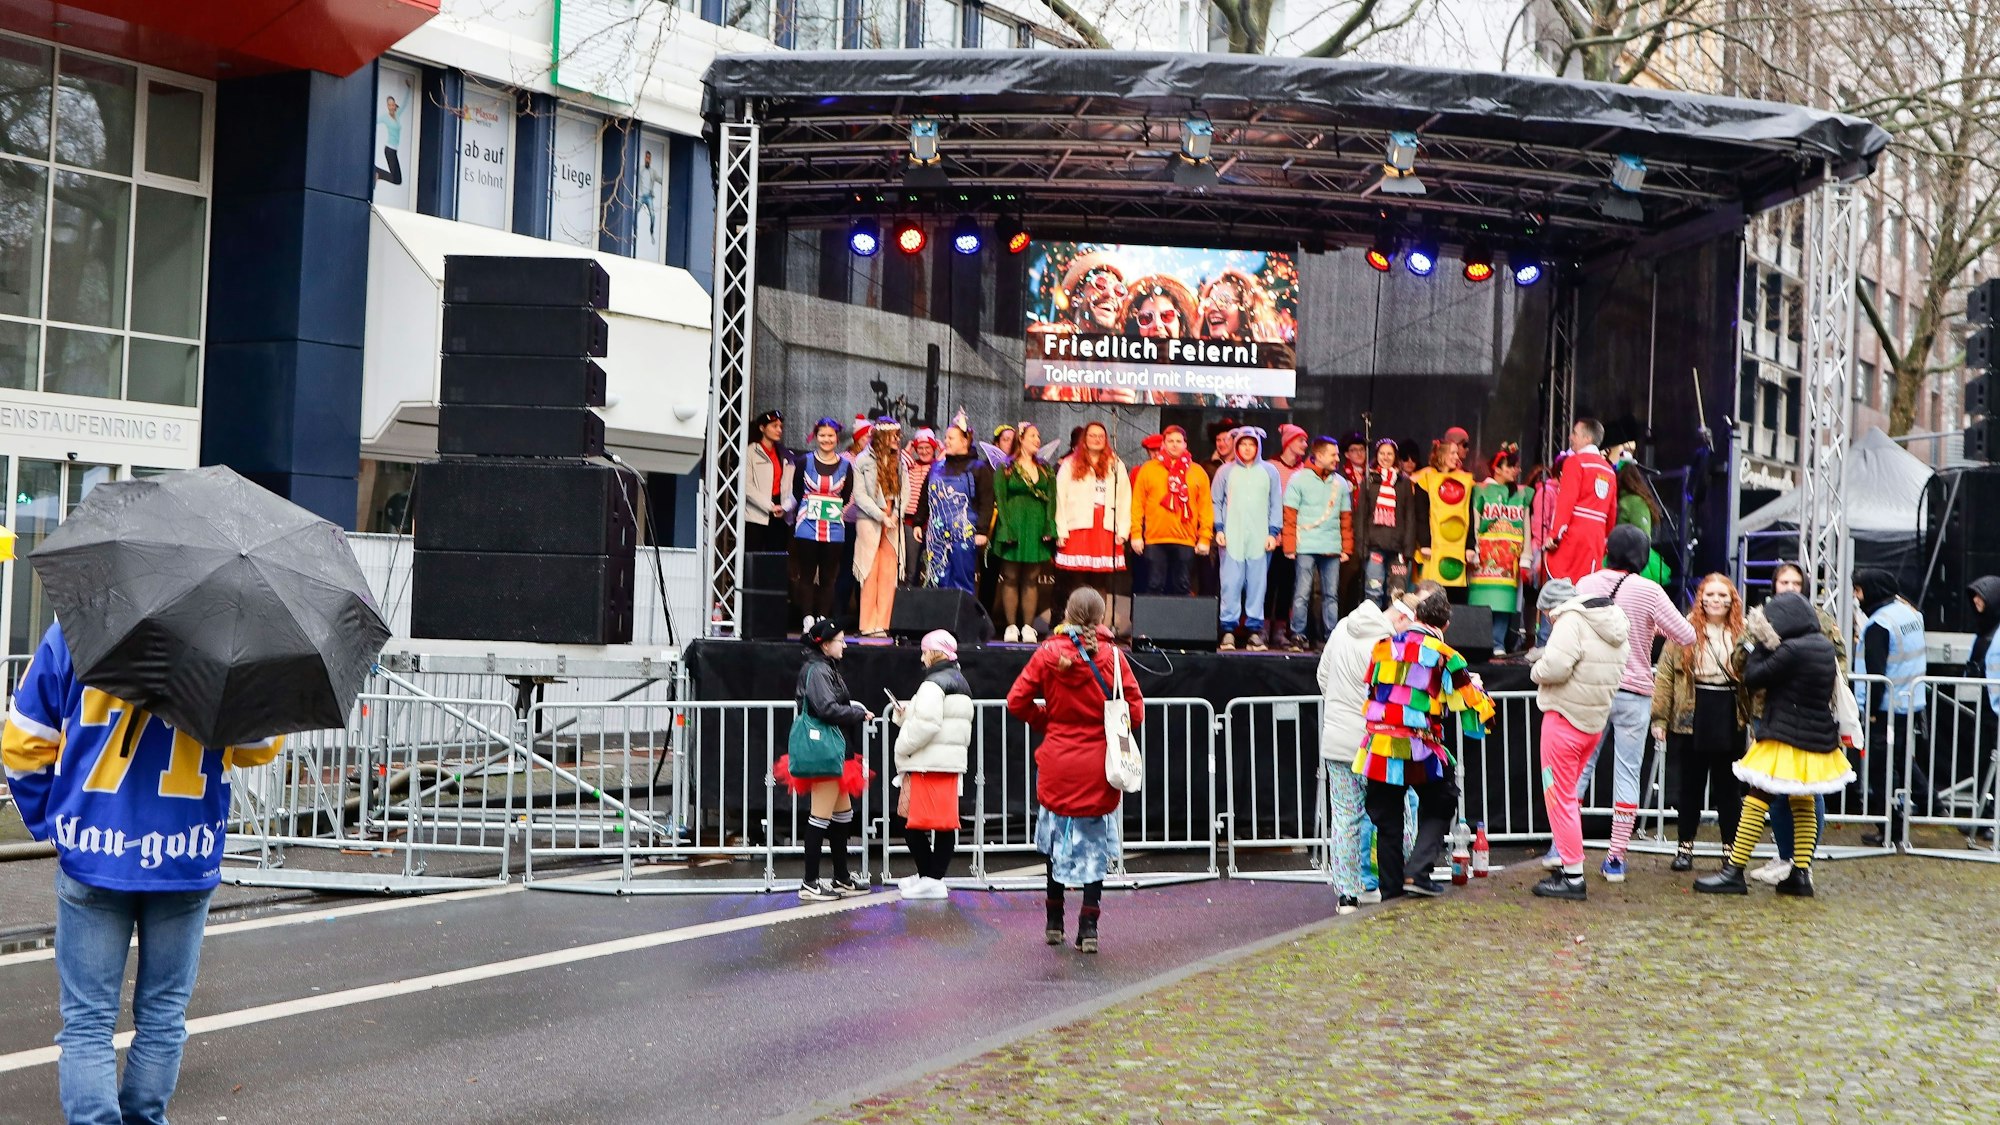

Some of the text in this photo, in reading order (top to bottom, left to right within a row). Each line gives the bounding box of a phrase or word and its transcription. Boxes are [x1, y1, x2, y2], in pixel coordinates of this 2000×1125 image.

[464, 139, 505, 165] ab auf
[464, 167, 503, 190] Es lohnt
[562, 163, 592, 189] Liege
[1044, 333, 1258, 364] Friedlich Feiern!
[1043, 364, 1251, 395] Tolerant und mit Respekt
[0, 407, 183, 443] ENSTAUFENRING 62
[80, 685, 207, 799] 71
